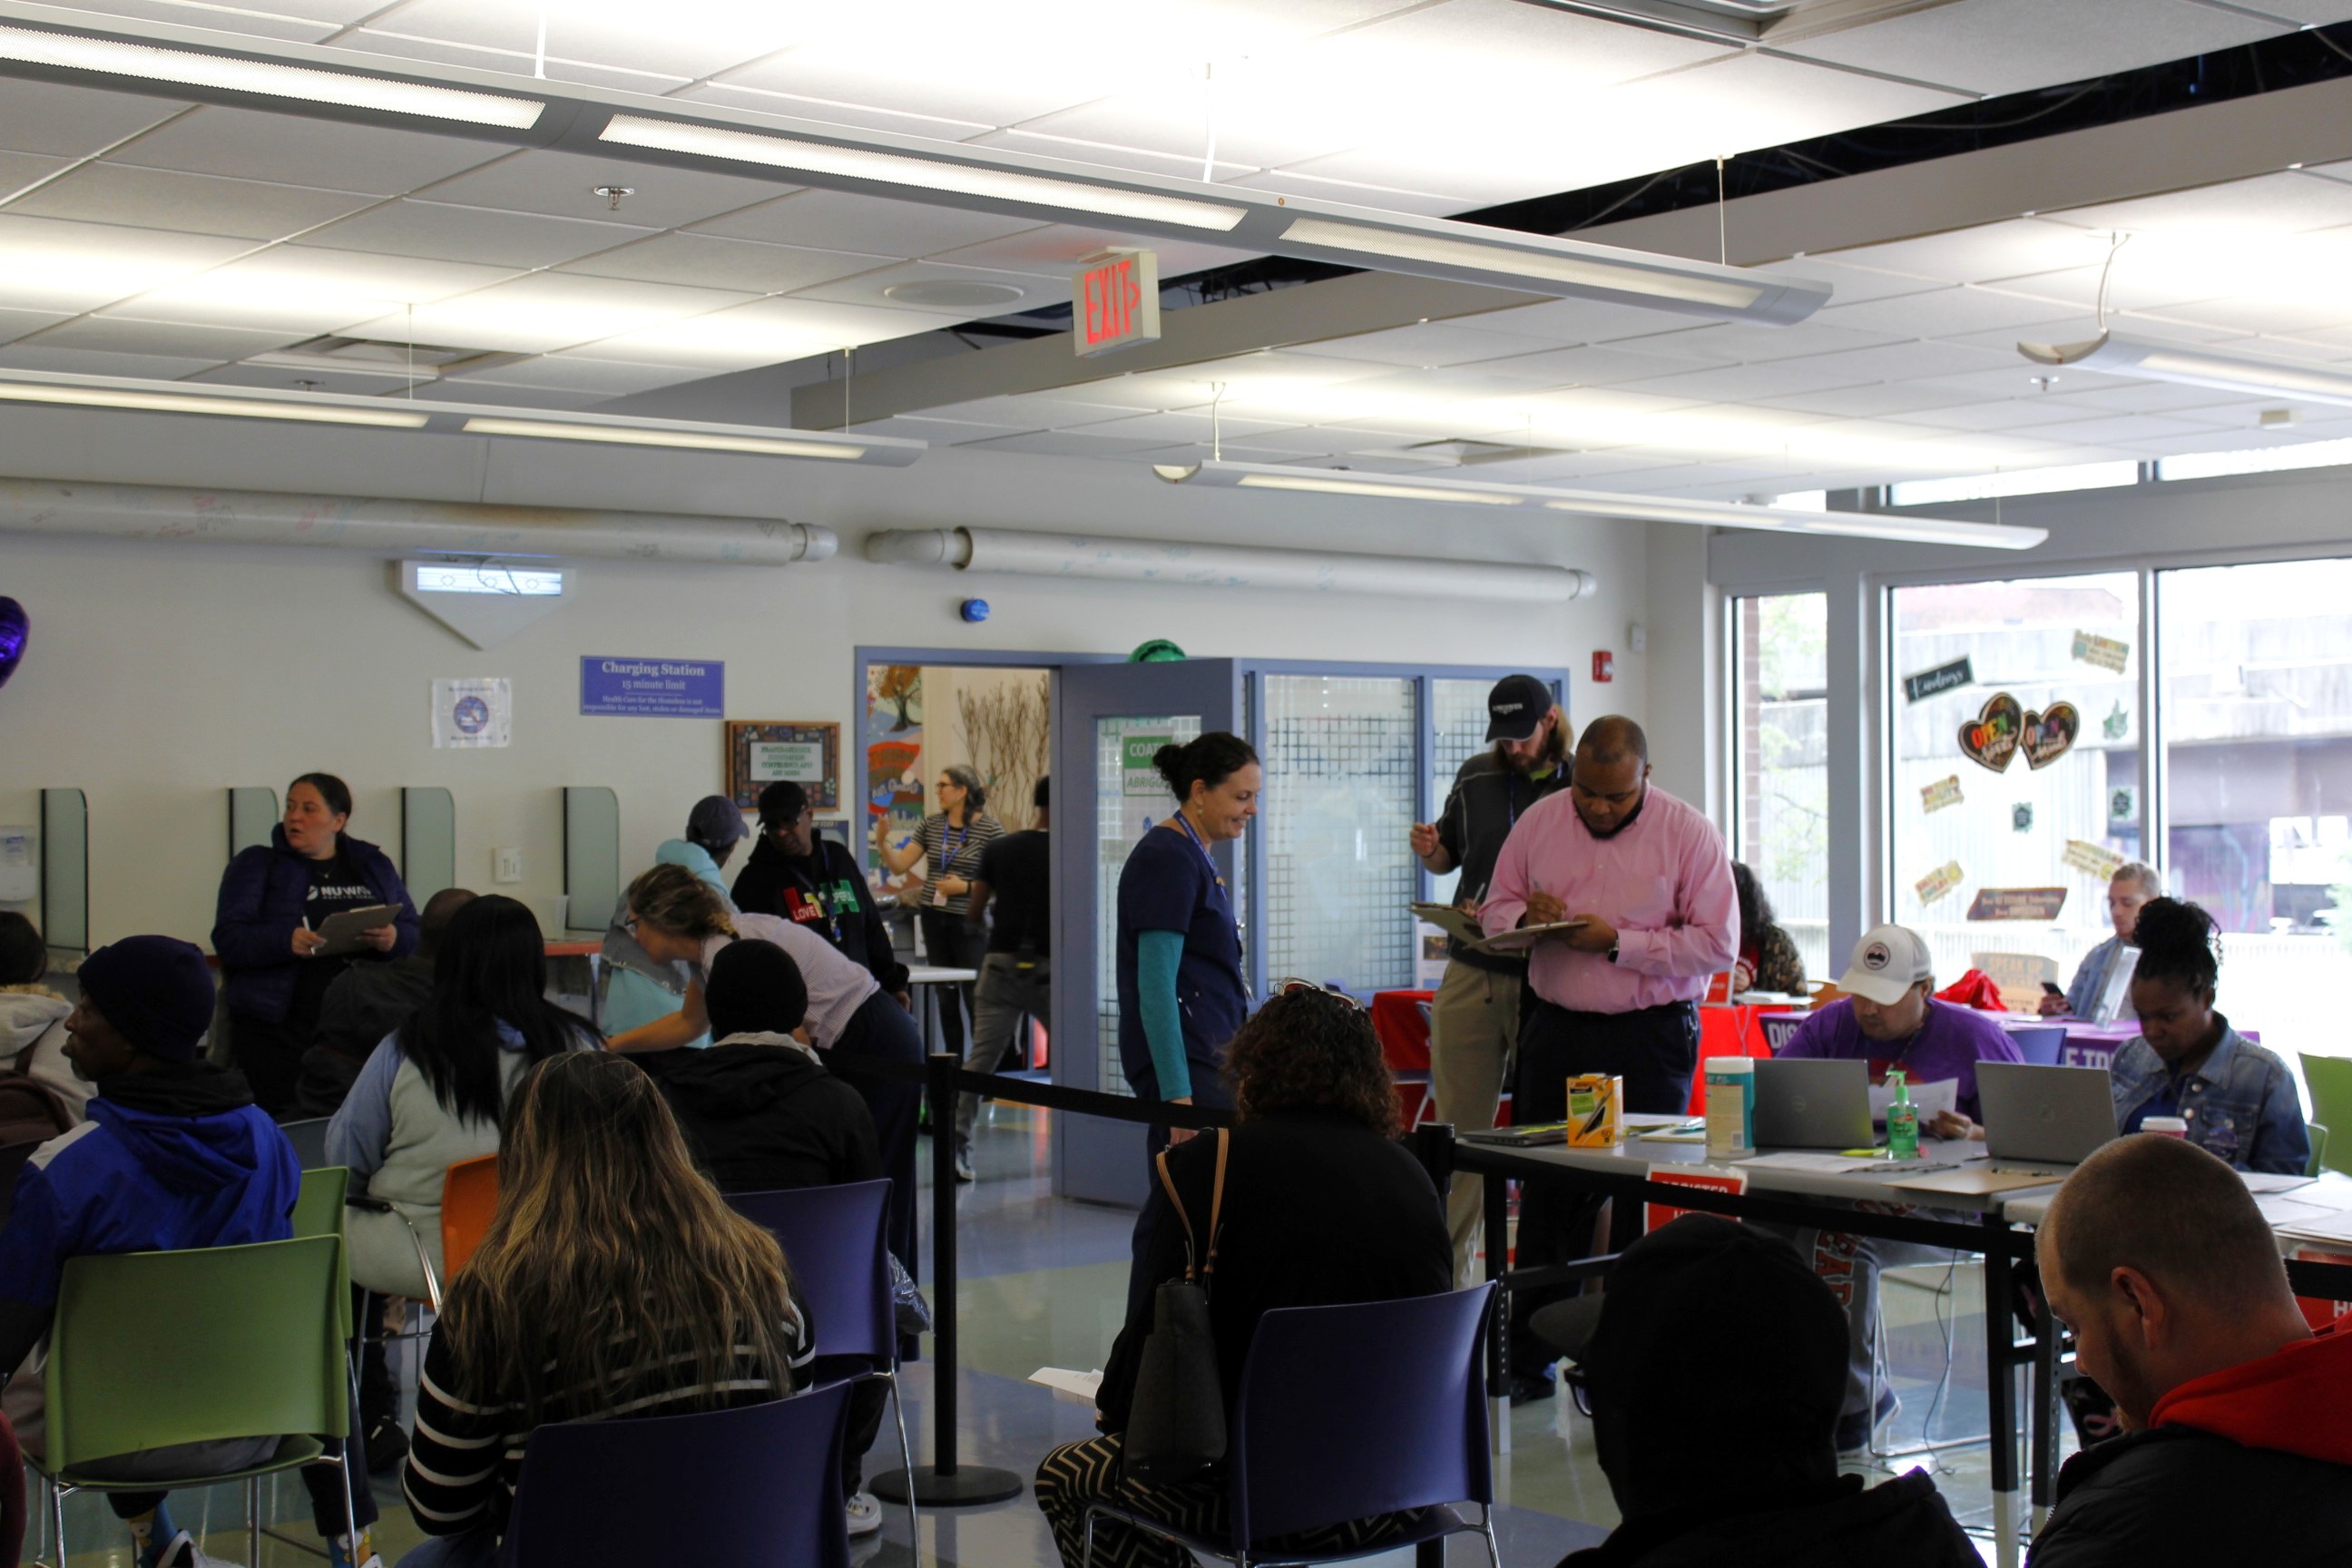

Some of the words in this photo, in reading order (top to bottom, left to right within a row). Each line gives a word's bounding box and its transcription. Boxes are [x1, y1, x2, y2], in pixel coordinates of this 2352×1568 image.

[1084, 260, 1132, 345] EXIT
[602, 661, 659, 678] Charging
[661, 662, 705, 677] Station
[622, 681, 632, 691] 15
[632, 680, 664, 690] minute
[665, 680, 686, 691] limit
[603, 695, 622, 703] Health
[637, 696, 647, 704] for
[658, 697, 686, 705] Homeless
[617, 703, 627, 711] for
[1971, 712, 2008, 750] OPEN
[2025, 718, 2061, 747] OPEN
[1129, 742, 1165, 757] COAT
[792, 906, 817, 921] LOVE
